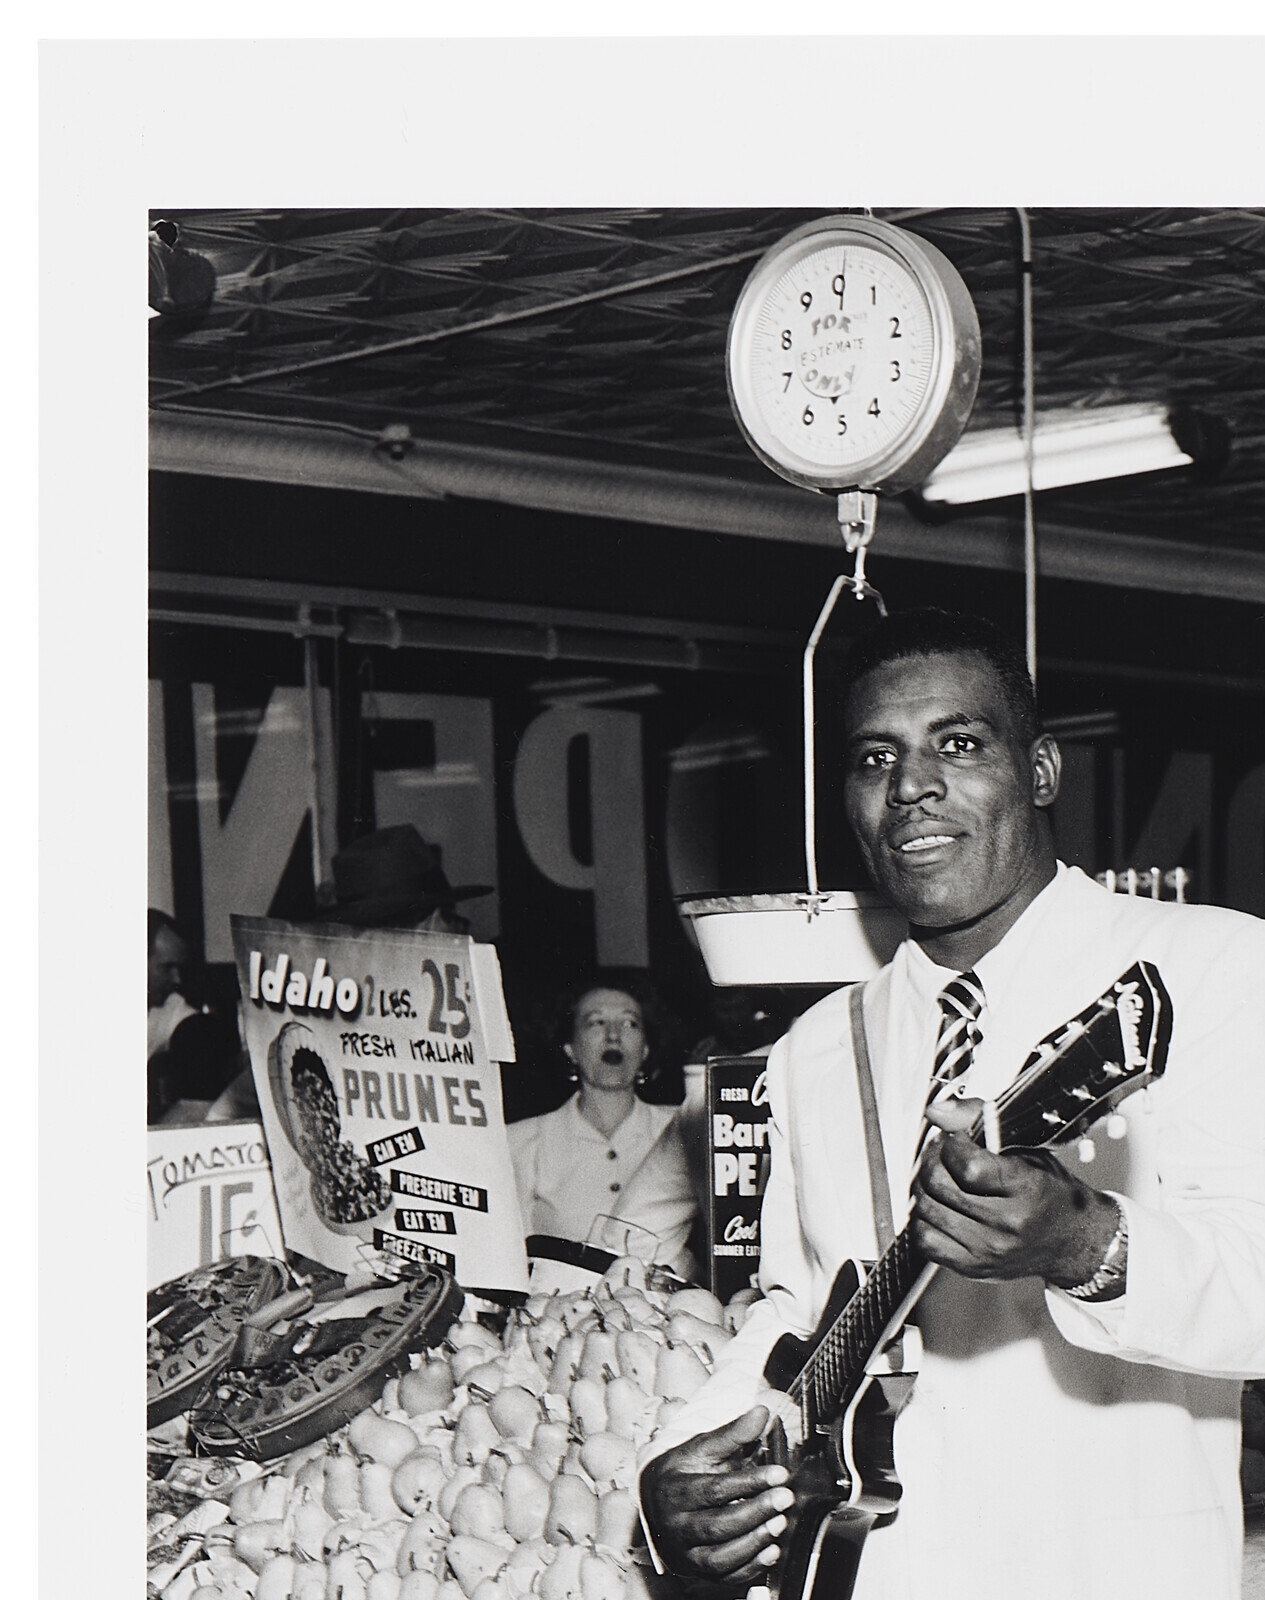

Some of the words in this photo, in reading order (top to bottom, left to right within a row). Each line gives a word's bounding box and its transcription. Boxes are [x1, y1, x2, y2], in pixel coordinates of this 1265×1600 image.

[832, 274, 845, 297] 0
[869, 285, 876, 306] 1
[800, 291, 813, 313] 9
[889, 317, 902, 338] 2
[781, 329, 792, 350] 8
[782, 371, 793, 393] 7
[890, 360, 901, 382] 3
[802, 404, 814, 426] 6
[867, 397, 881, 418] 4
[837, 414, 848, 436] 5
[250, 950, 361, 1014] Idaho
[364, 974, 375, 1017] 2
[340, 1032, 398, 1059] FRESH
[409, 1038, 476, 1066] ITALIAN
[341, 1067, 489, 1128] PRUNES
[721, 1087, 750, 1102] FRESH
[373, 1138, 398, 1163] CAN
[394, 1131, 418, 1155] 'EM
[399, 1172, 458, 1204] PRESERVE
[458, 1185, 480, 1209] 'EM
[402, 1210, 426, 1231] EAT
[425, 1211, 449, 1233] 'EM
[713, 1244, 745, 1257] SUMMER
